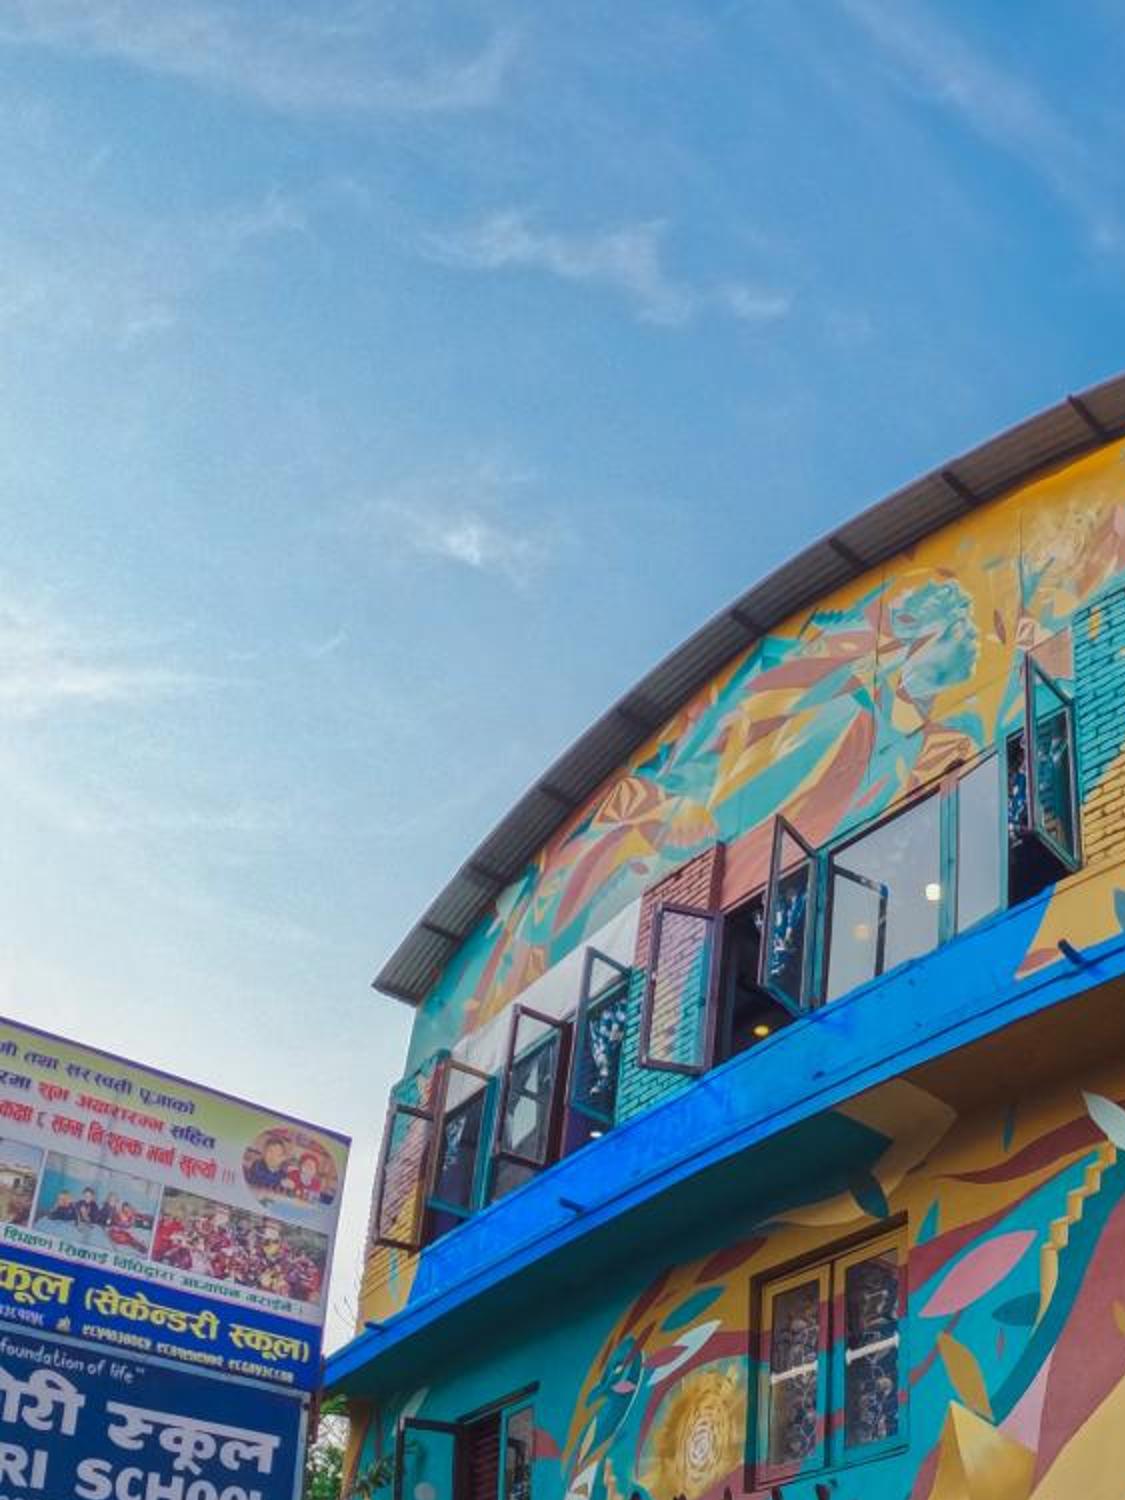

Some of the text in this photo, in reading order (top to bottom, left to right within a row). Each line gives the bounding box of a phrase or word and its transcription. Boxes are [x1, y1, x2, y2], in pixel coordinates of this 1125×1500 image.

[24, 1052, 59, 1071] तथा
[87, 1359, 105, 1376] of
[106, 1400, 281, 1475] स्कूल
